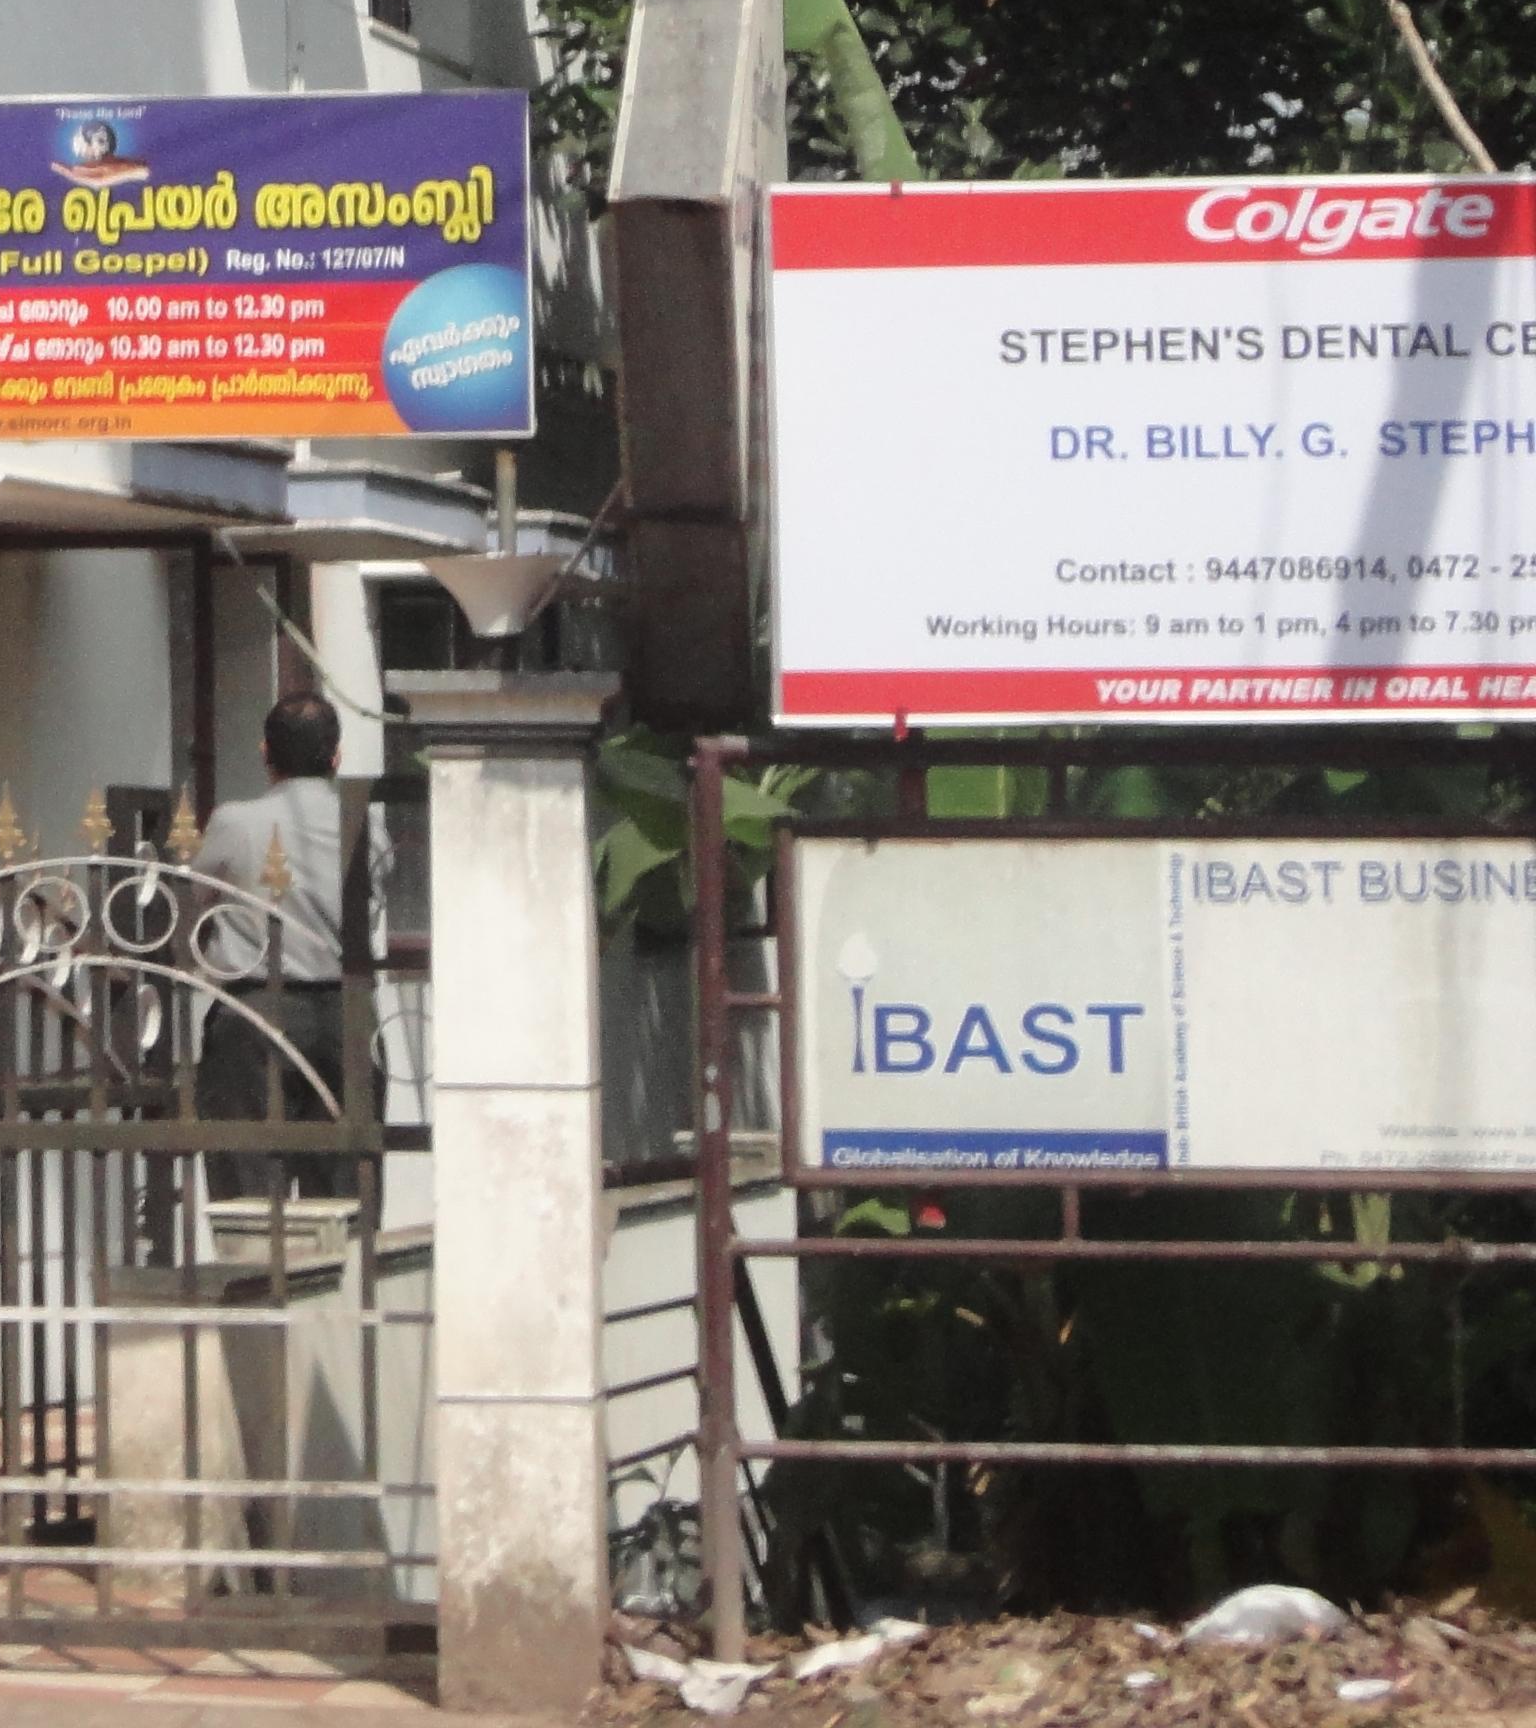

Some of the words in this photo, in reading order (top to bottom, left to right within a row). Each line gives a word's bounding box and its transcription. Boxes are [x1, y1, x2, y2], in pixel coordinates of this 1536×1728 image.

[1185, 186, 1495, 255] Colgate
[74, 246, 209, 278] Gospel)
[226, 248, 271, 276] Reg.
[322, 245, 407, 270] 127/07/N
[106, 294, 163, 321] 10.00
[166, 300, 200, 320] am
[205, 296, 228, 320] to
[234, 293, 286, 319] 12.30
[289, 298, 325, 323] pm
[109, 333, 163, 360] 10.30
[166, 339, 200, 359] am
[205, 335, 228, 358] to
[234, 332, 286, 357] 12.30
[289, 336, 325, 362] pm
[1000, 326, 1265, 364] STEPHEN'S
[1282, 322, 1471, 360] DENTAL
[1051, 424, 1128, 461] DR.
[1147, 423, 1284, 460] BILLY.
[1300, 422, 1349, 459] G.
[1379, 418, 1536, 457] STEPH
[1407, 553, 1480, 582] 0472
[927, 614, 1038, 643] Working
[1046, 613, 1135, 638] Hours:
[1145, 613, 1160, 637] 9
[1170, 619, 1209, 637] am
[1218, 614, 1244, 637] to
[1254, 612, 1265, 636] 1
[1277, 618, 1327, 643] pm,
[1335, 611, 1351, 635] 4
[1358, 617, 1401, 641] pm
[1409, 611, 1436, 635] to
[1444, 610, 1500, 634] 7.30
[1094, 678, 1180, 705] YOUR
[1188, 677, 1333, 704] PARTNER
[1341, 676, 1376, 703] IN
[1383, 675, 1470, 702] ORAL
[1192, 860, 1344, 904] IBAST
[851, 985, 1146, 1075] IBAST
[994, 1147, 1020, 1169] of
